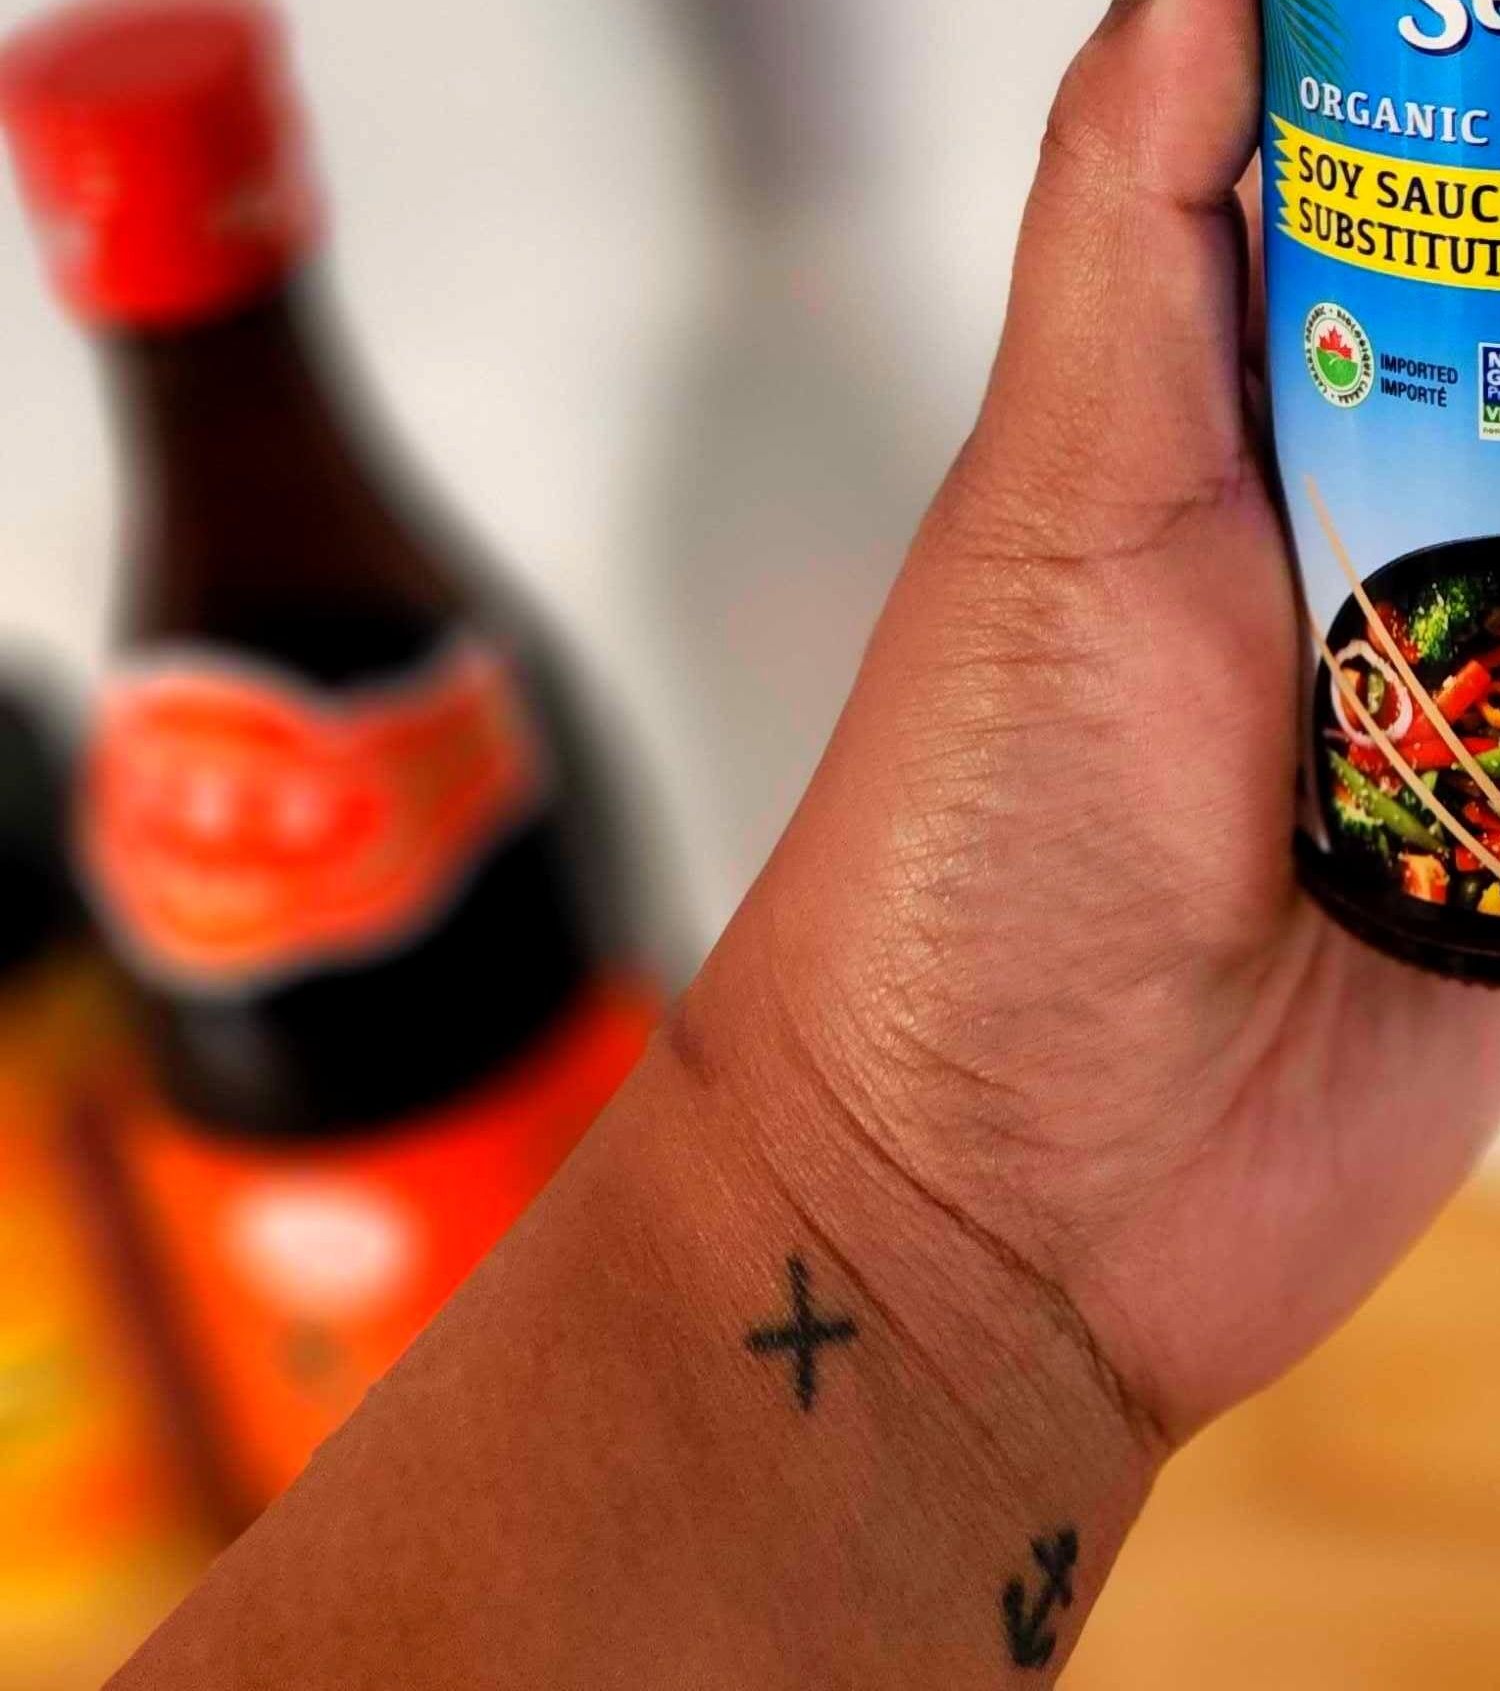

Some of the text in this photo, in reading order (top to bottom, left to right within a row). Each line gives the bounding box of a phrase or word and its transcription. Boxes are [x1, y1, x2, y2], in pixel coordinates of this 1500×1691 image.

[1299, 76, 1490, 145] ORGANIC
[1298, 145, 1365, 200] SOY
[1381, 353, 1459, 385] IMPORTED
[1381, 377, 1447, 408] IMPORTÉ
